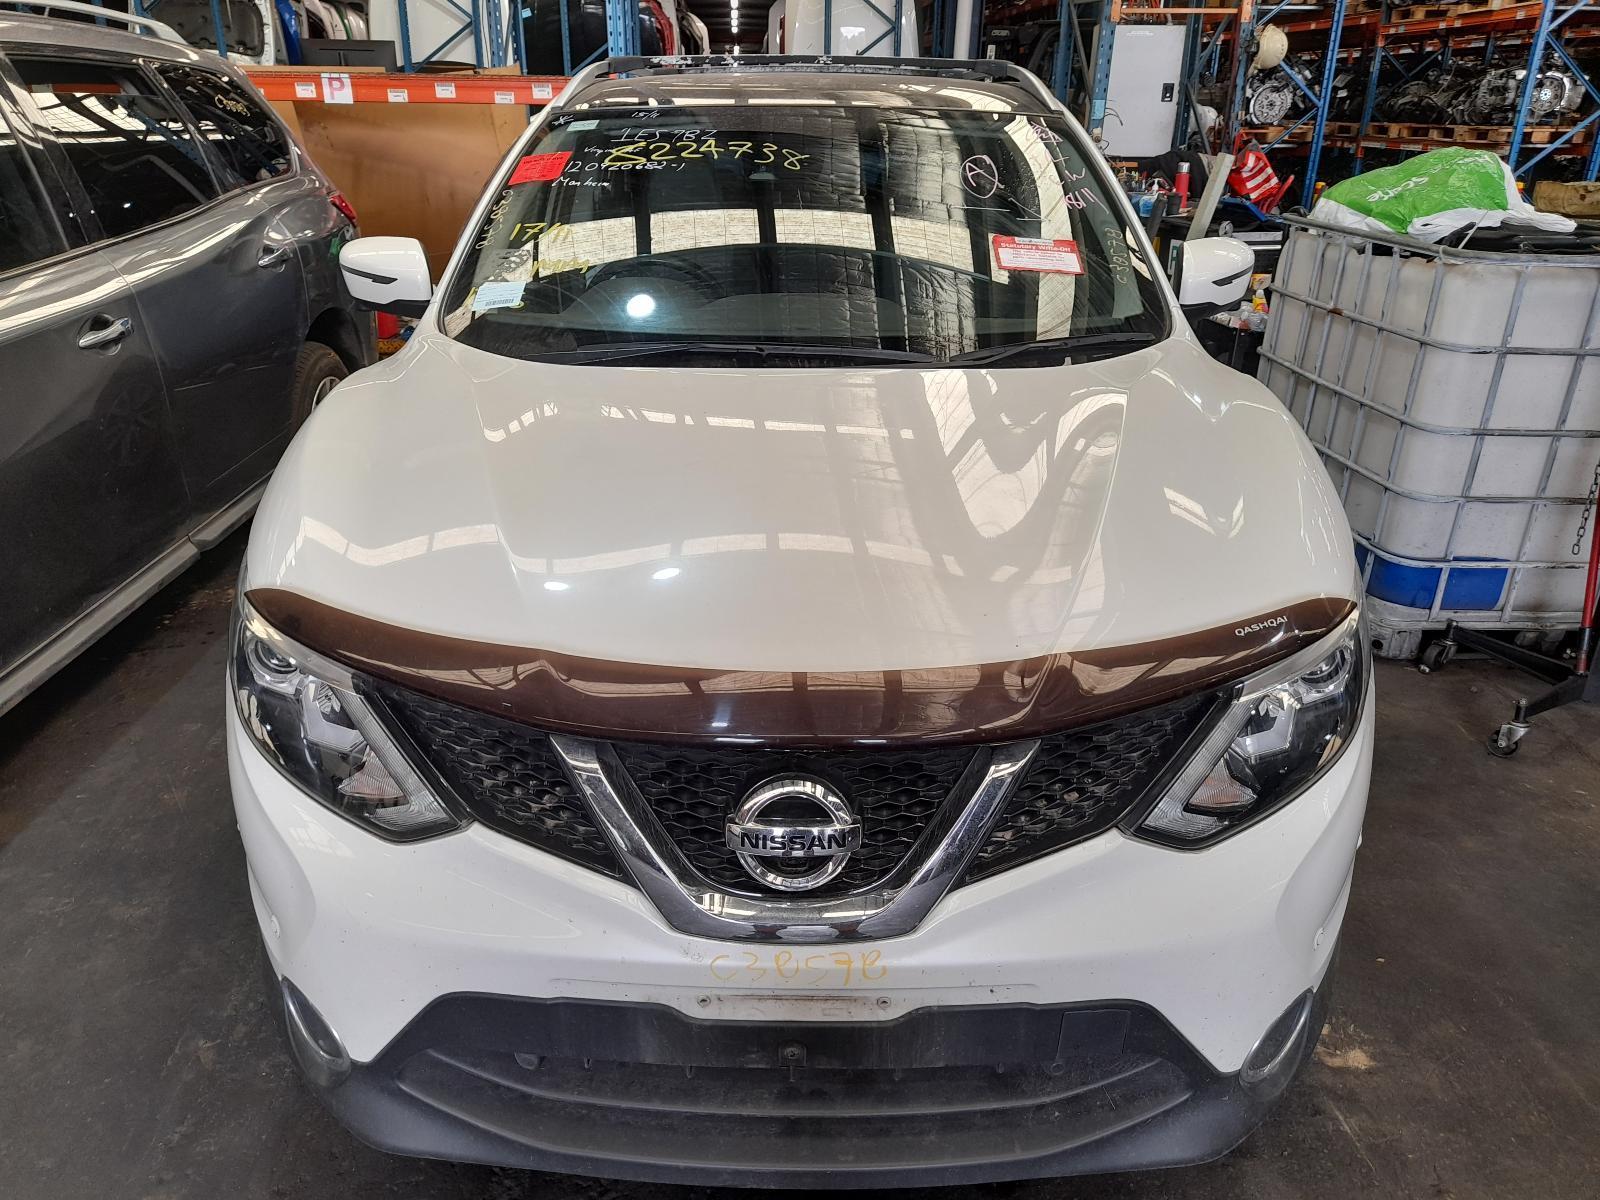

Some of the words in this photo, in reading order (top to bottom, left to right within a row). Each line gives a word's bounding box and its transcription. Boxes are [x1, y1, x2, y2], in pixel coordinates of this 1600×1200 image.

[328, 77, 345, 100] P
[1234, 615, 1288, 636] QASHQAI
[740, 832, 847, 851] NISSAN
